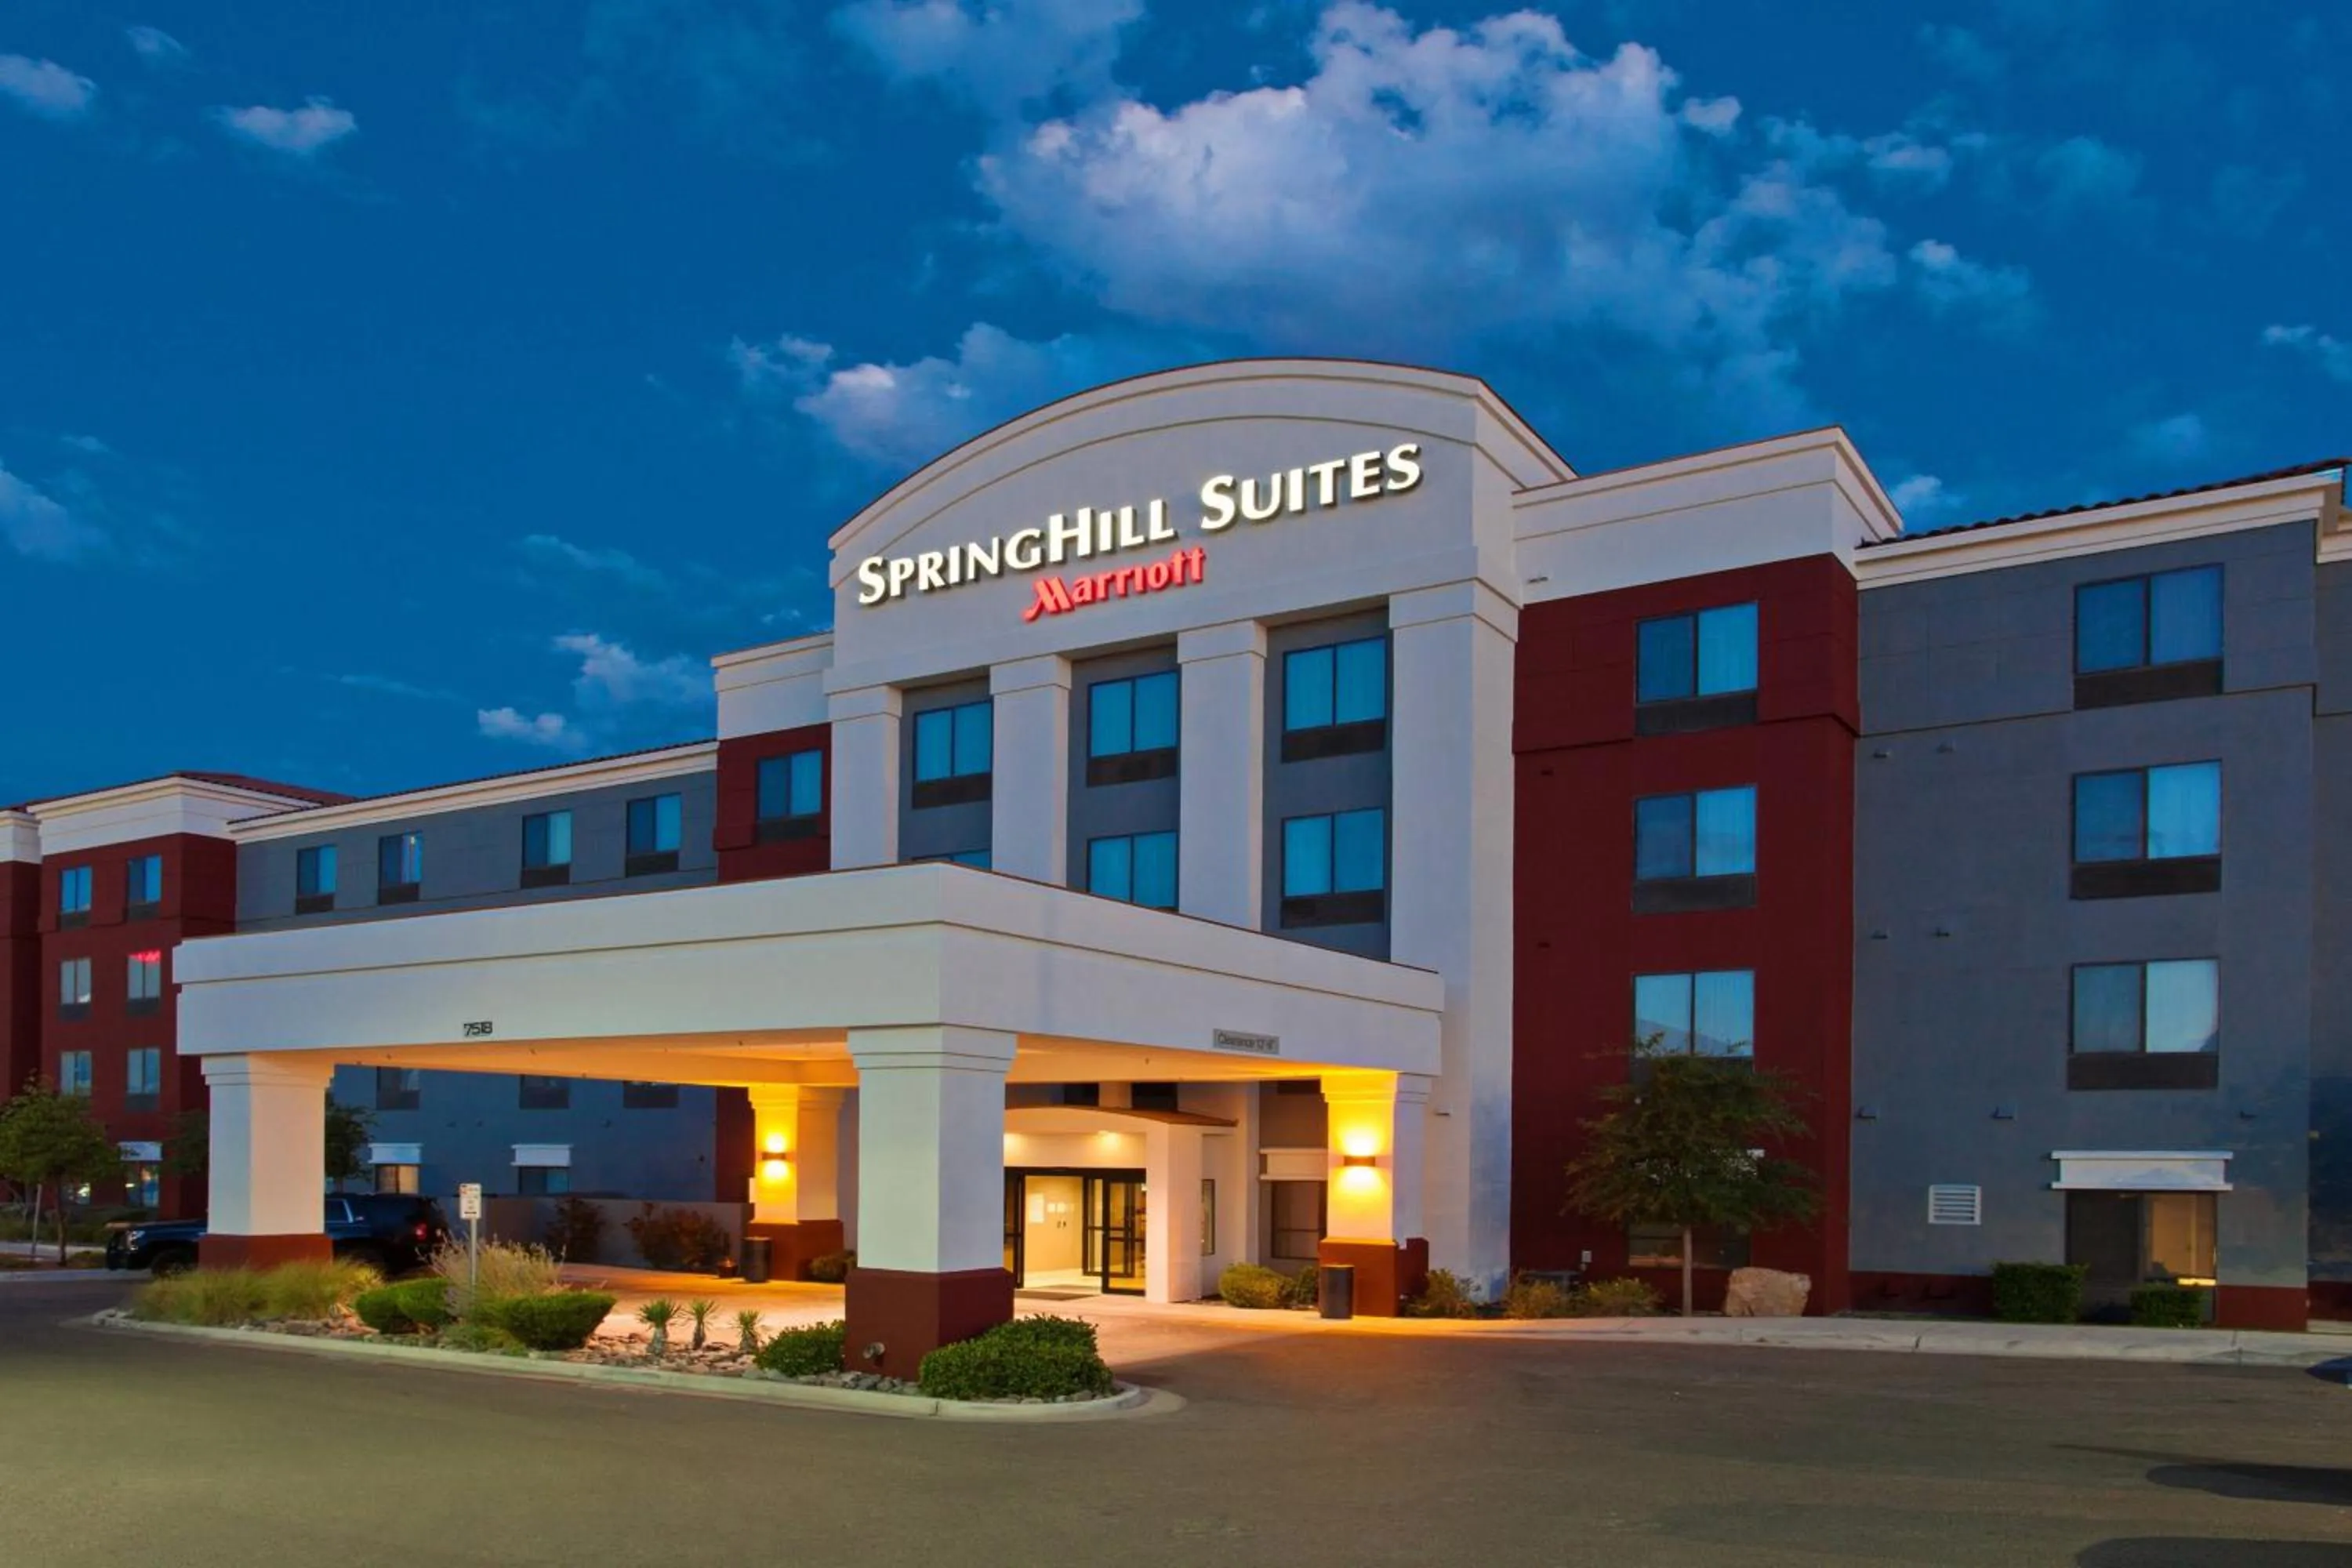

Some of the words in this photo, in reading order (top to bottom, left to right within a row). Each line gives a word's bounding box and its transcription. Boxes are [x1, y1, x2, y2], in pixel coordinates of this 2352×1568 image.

[858, 499, 1175, 605] SPRINGHILL
[1200, 443, 1423, 530] SUITES
[1023, 547, 1205, 622] Marriott
